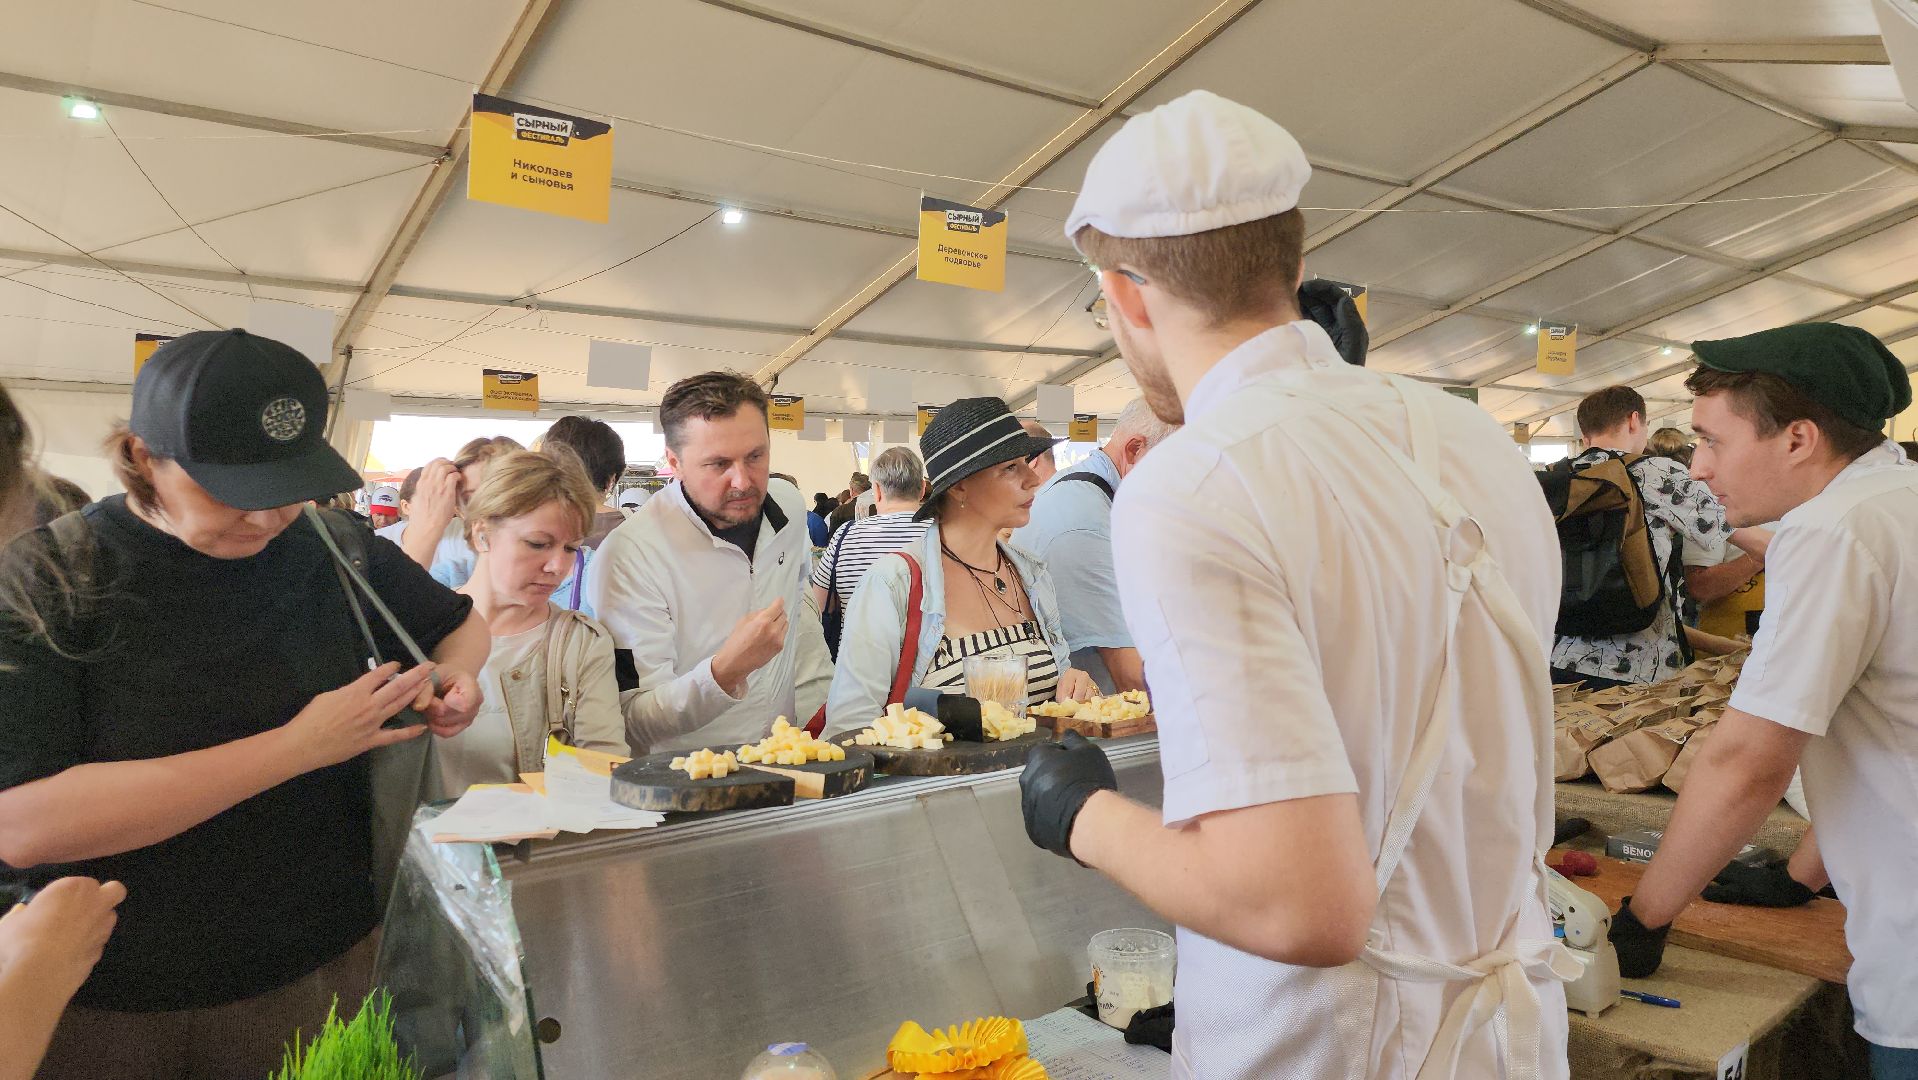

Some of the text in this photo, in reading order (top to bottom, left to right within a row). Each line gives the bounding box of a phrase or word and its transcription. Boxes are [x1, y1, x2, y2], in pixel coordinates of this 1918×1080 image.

[516, 117, 568, 133] СЫРНЫЙ
[521, 131, 565, 144] ФЕСТИВАЛЬ
[513, 158, 573, 179] Николаев
[511, 172, 574, 191] и сыновья
[947, 212, 980, 223] СЫРНЫЙ
[944, 256, 981, 269] подворье
[1622, 844, 1655, 858] BENO
